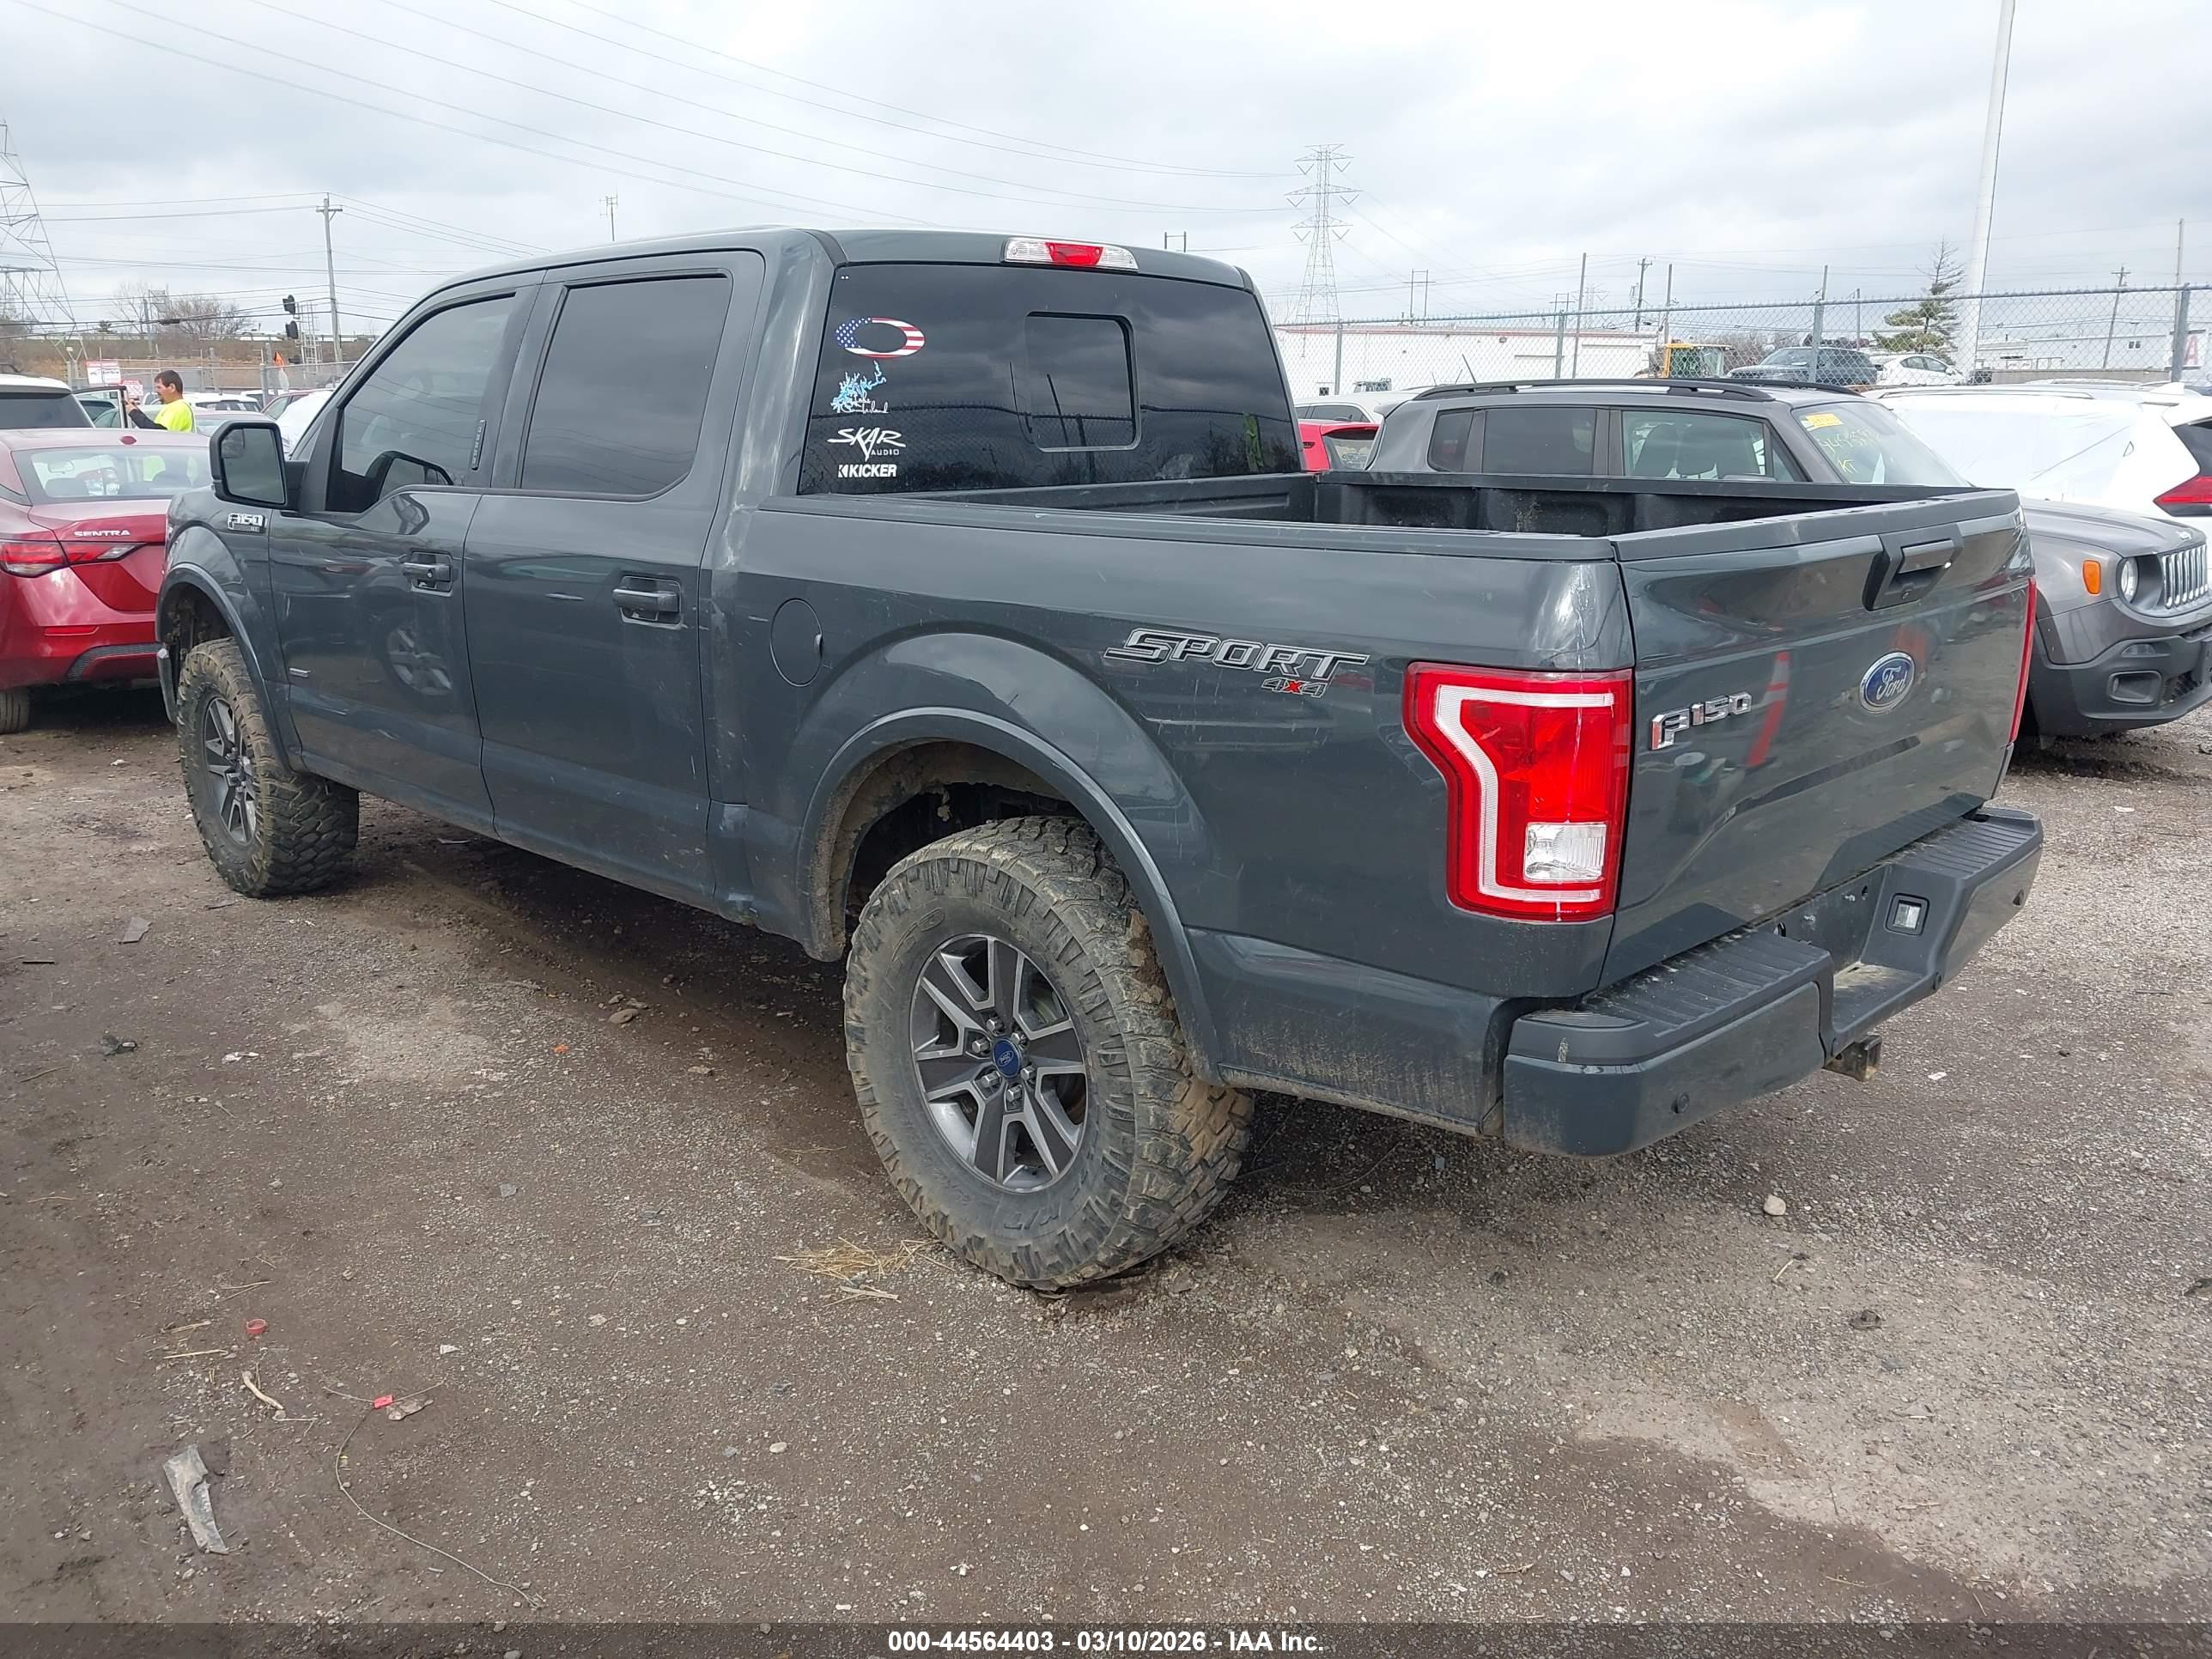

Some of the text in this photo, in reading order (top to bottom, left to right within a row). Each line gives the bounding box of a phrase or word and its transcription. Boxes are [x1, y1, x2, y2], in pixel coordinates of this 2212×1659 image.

[827, 427, 906, 462] SKAR
[848, 464, 897, 478] KICKER
[1103, 628, 1370, 682] SPORT
[1875, 665, 1908, 701] Ford
[1650, 691, 1752, 750] F150
